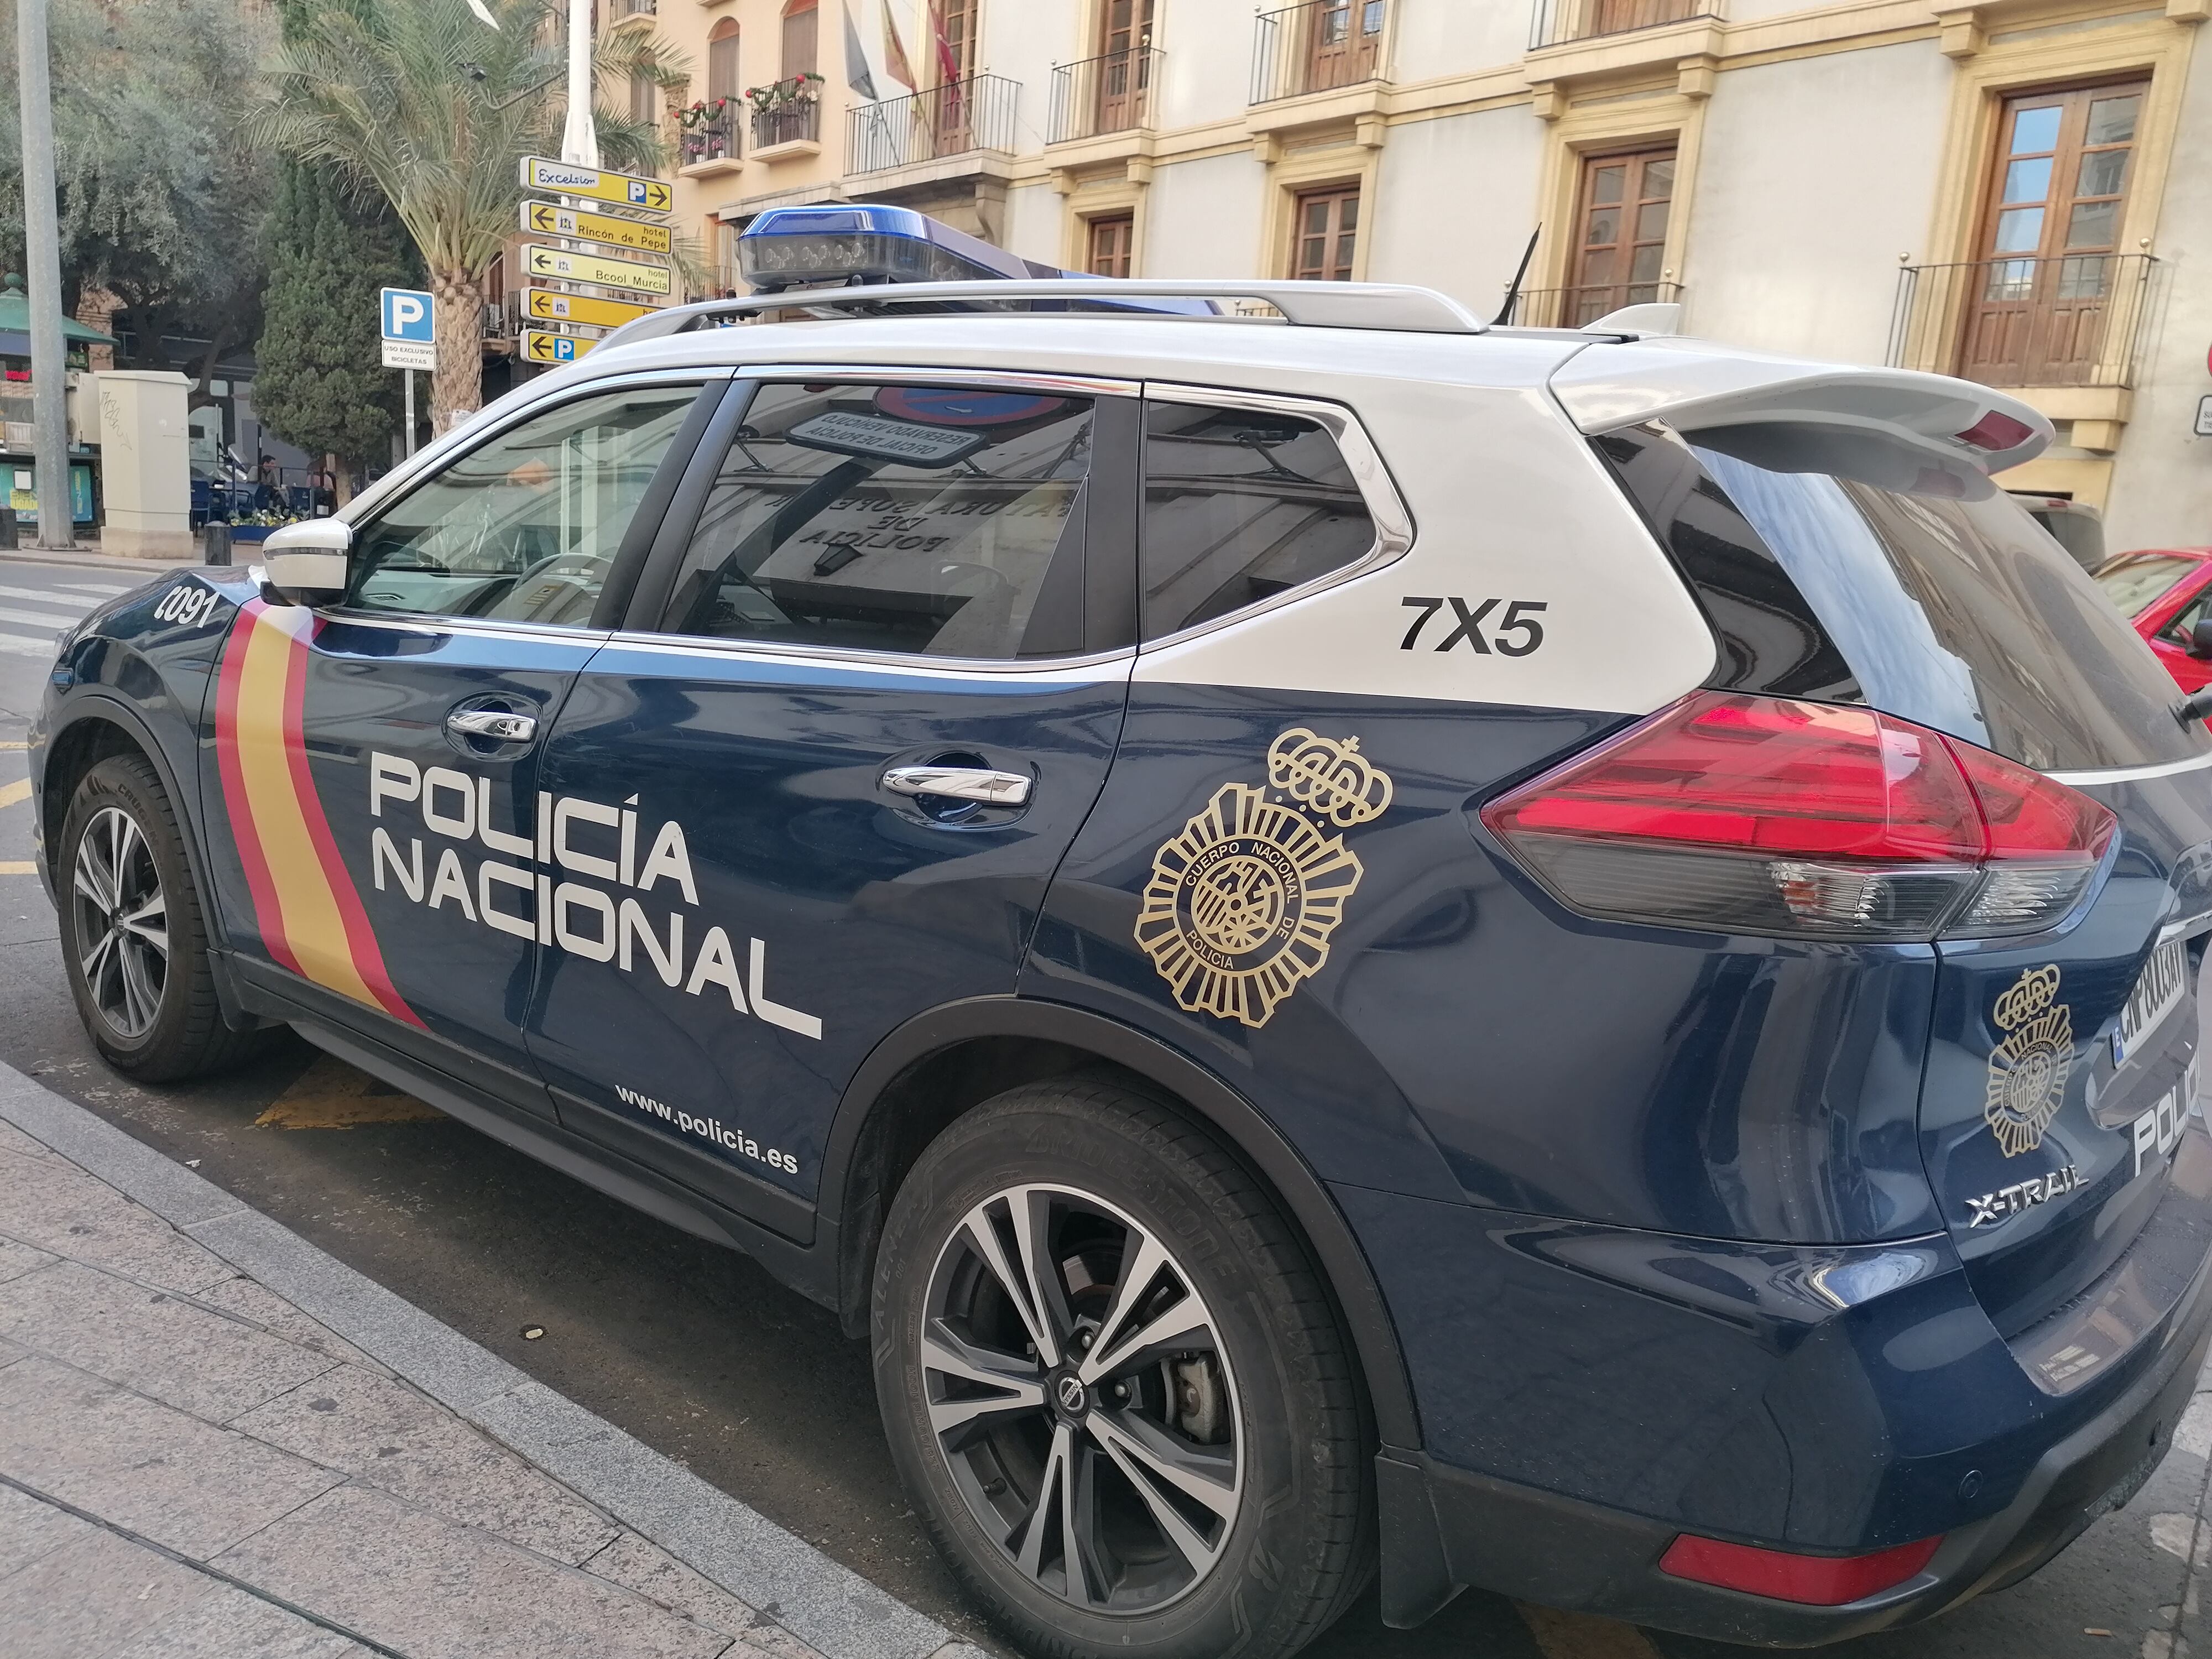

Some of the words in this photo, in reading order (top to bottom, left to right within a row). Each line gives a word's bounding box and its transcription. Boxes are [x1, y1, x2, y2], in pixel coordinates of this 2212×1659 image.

[538, 169, 596, 185] Excelsior
[630, 182, 646, 200] P
[578, 225, 614, 240] Rincón
[621, 233, 634, 244] de
[641, 236, 666, 250] Pepe
[643, 226, 667, 238] hotel
[596, 269, 627, 283] Bcool
[633, 276, 667, 290] Murcia
[648, 269, 668, 279] hotel
[393, 295, 425, 335] P
[391, 356, 427, 365] BICICLETAS
[400, 346, 434, 356] EXCLUSIVO
[1400, 596, 1548, 657] 7X5
[371, 751, 700, 907] POLICÍA
[1185, 841, 1241, 887] CUERPO
[1250, 841, 1300, 905] NACIONAL
[372, 827, 822, 1041] NACIONAL
[1276, 916, 1295, 940] DE
[1186, 929, 1234, 970] POLICIA
[614, 1084, 799, 1175] www.policia.es
[1965, 1164, 2089, 1229] X-TRAIL
[908, 1313, 917, 1346] TUBELESS
[1061, 1383, 1079, 1406] NISSAN
